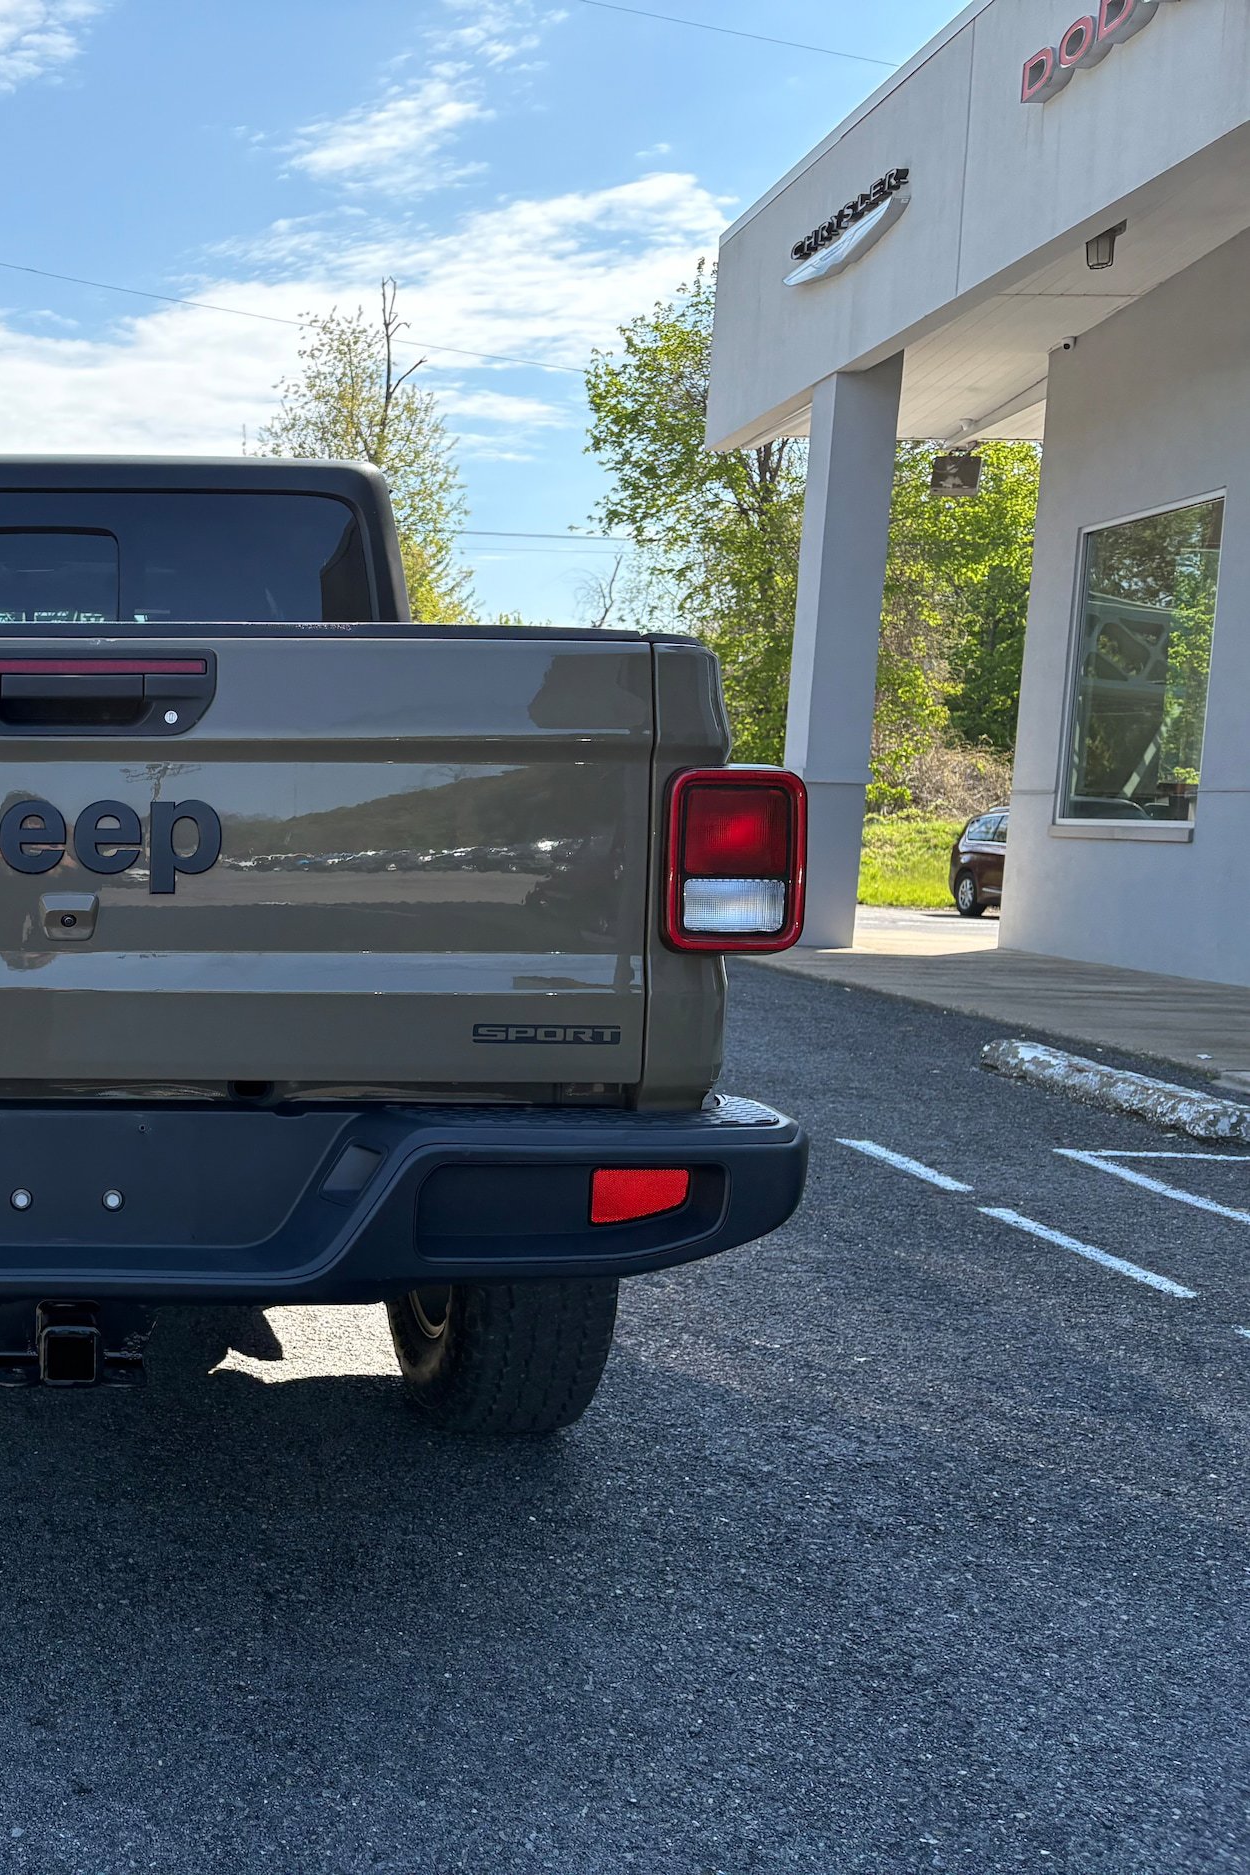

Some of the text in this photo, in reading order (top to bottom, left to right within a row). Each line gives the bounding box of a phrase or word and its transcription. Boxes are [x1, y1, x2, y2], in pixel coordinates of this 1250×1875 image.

[1020, 0, 1153, 103] DOD
[791, 168, 910, 260] CHRYSLER
[472, 1025, 621, 1043] SPORT
